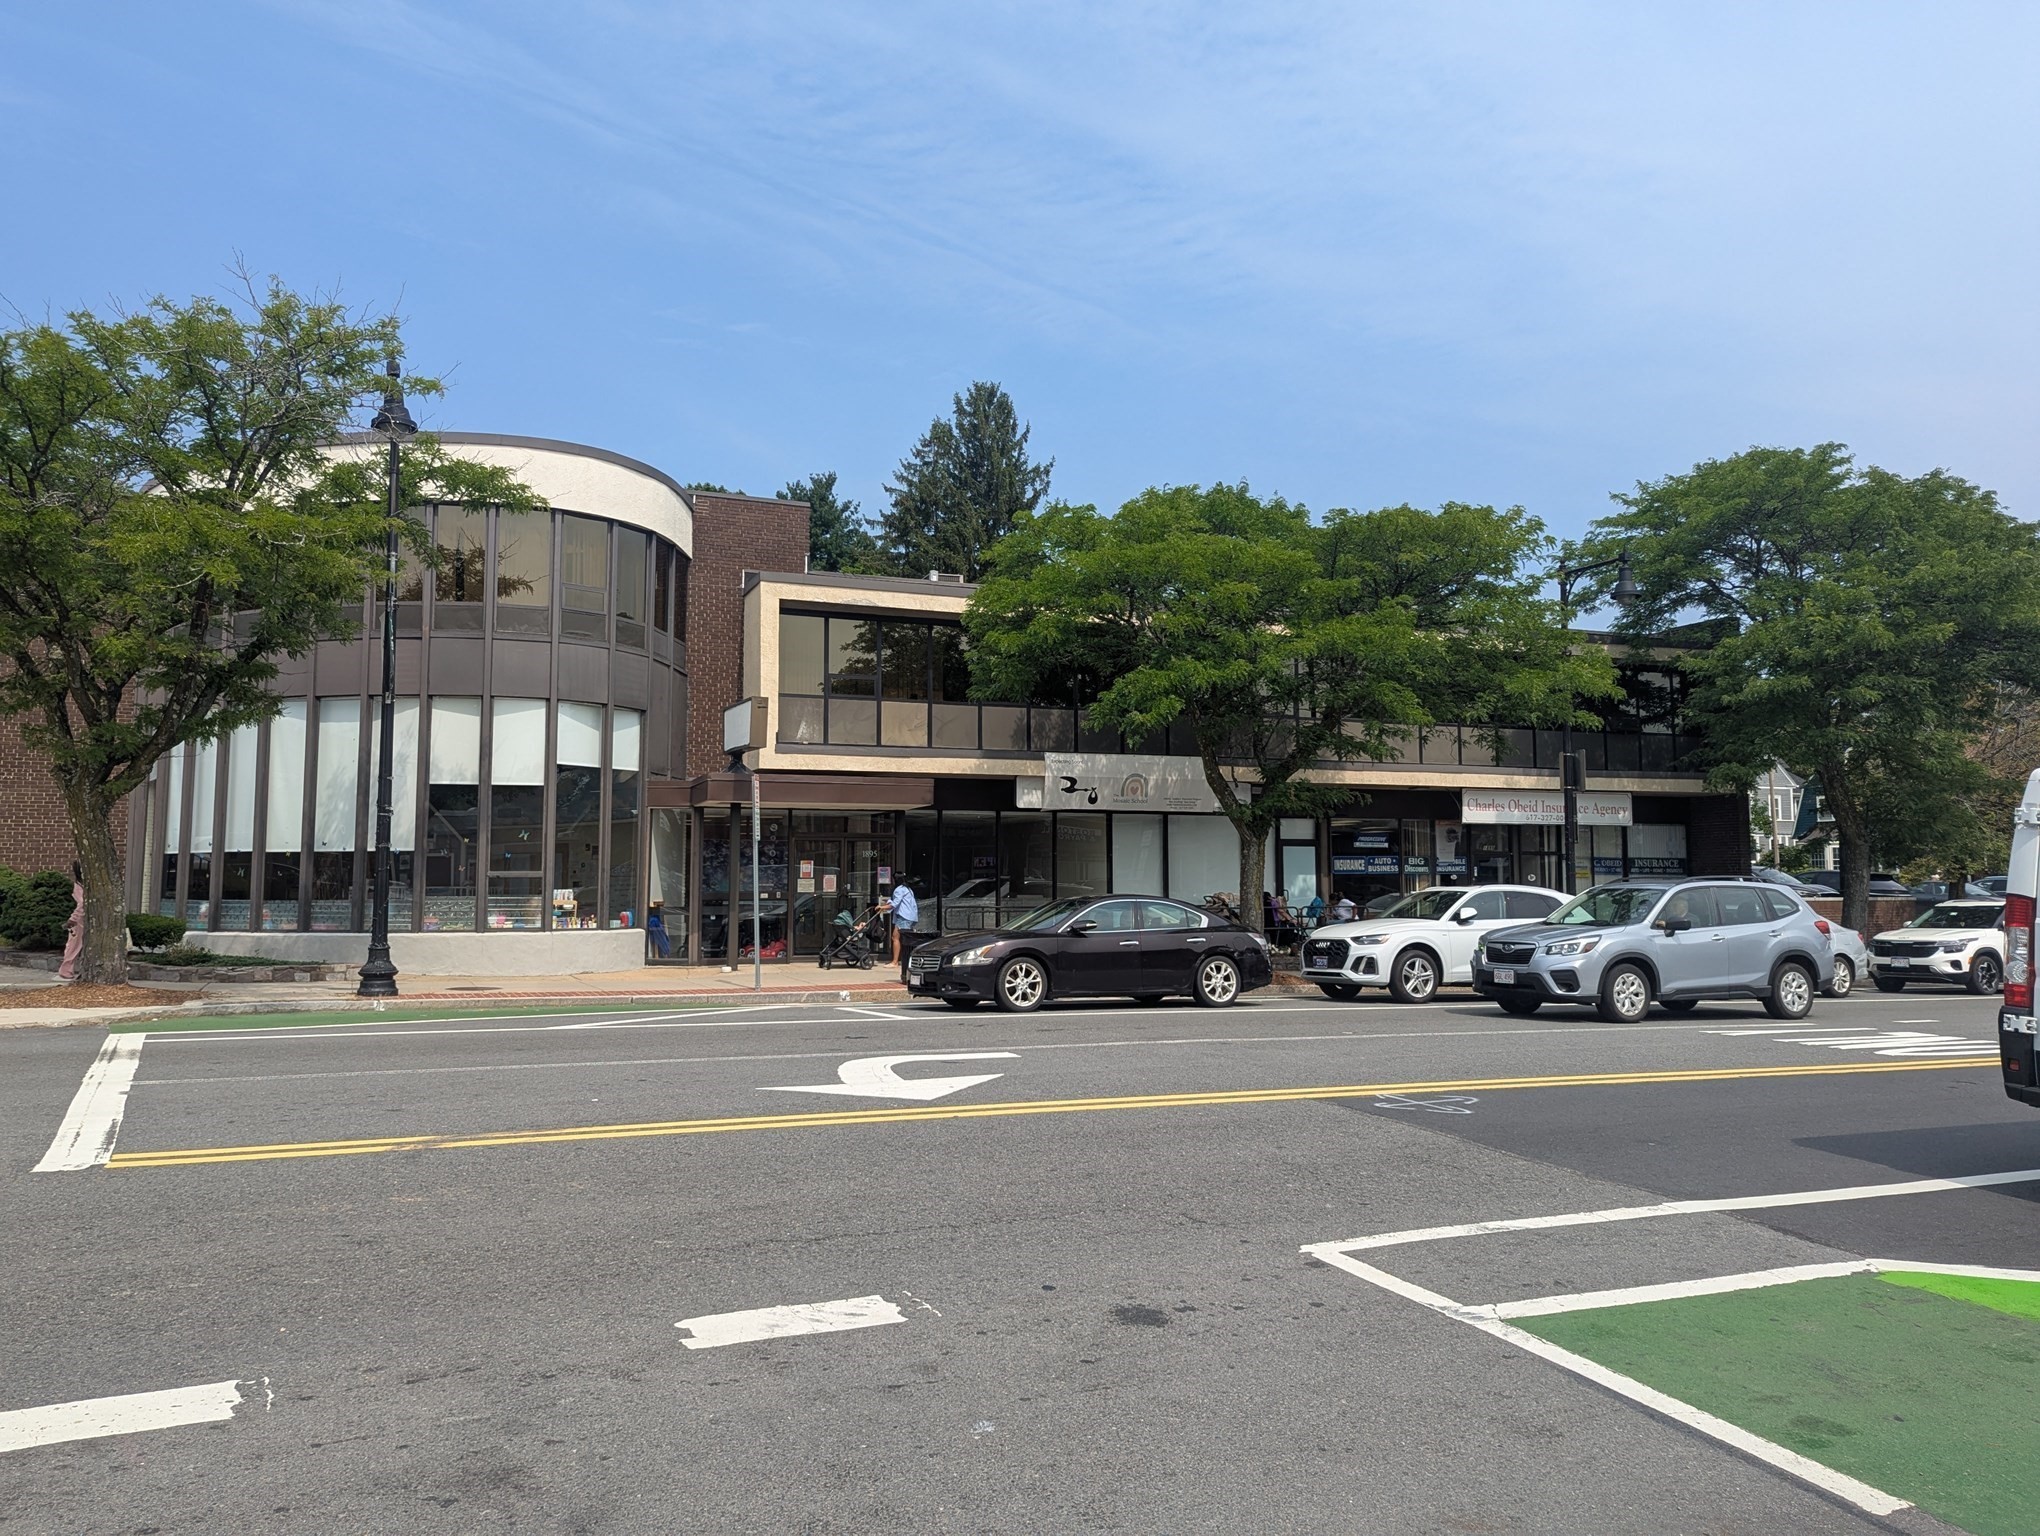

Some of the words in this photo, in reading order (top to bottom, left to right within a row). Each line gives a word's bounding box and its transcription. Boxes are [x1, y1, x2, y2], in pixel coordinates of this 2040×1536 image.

[1467, 798, 1505, 812] Charles
[1508, 799, 1538, 813] Obeid
[1541, 800, 1589, 814] Insuce
[1592, 803, 1628, 818] Agency
[1525, 814, 1564, 822] 617-327-00
[862, 850, 878, 858] 1895
[1334, 859, 1365, 871] INSURANCE
[1408, 857, 1425, 865] BIG
[1635, 859, 1679, 868] INSURANCE
